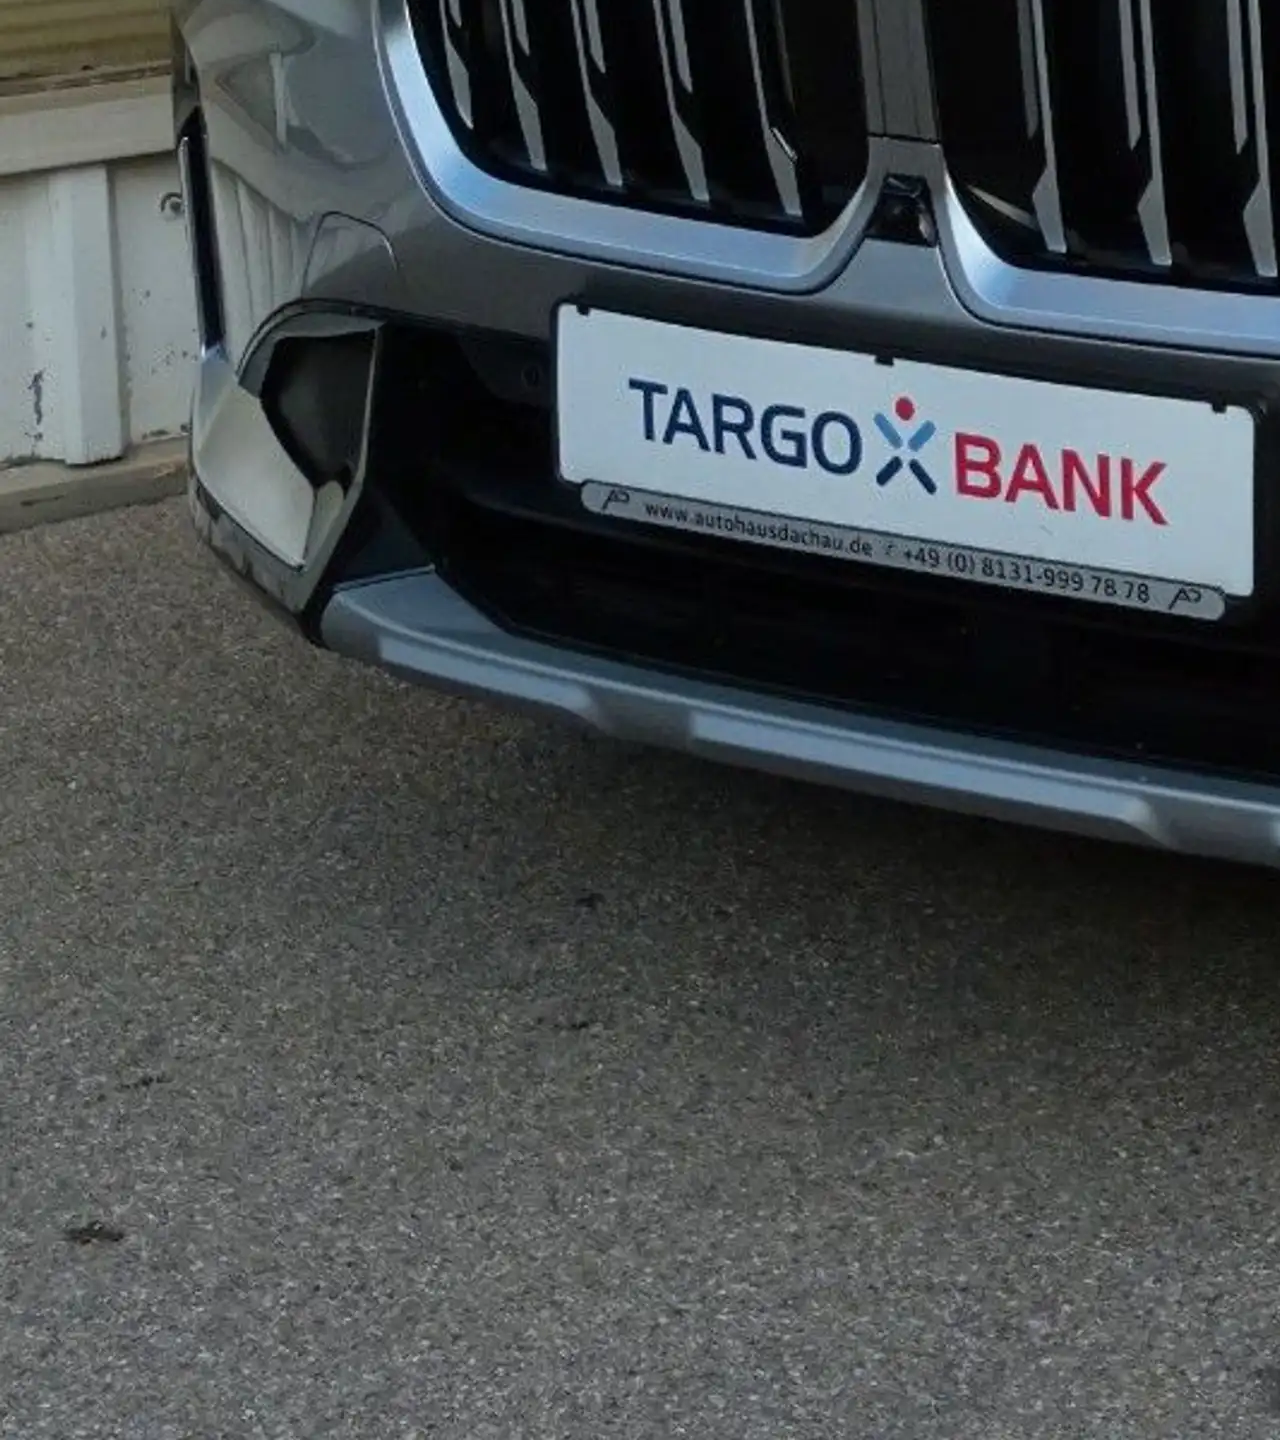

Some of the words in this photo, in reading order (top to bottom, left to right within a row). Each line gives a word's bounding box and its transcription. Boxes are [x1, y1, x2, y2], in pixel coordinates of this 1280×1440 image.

[627, 377, 863, 475] TARGO
[954, 431, 1170, 527] BANK
[644, 501, 874, 558] www.autohausdachau.de
[904, 547, 942, 569] +49
[947, 554, 976, 576] (0)
[981, 559, 1085, 592] 8131-999
[1091, 575, 1118, 598] 78
[1124, 580, 1150, 604] 78
